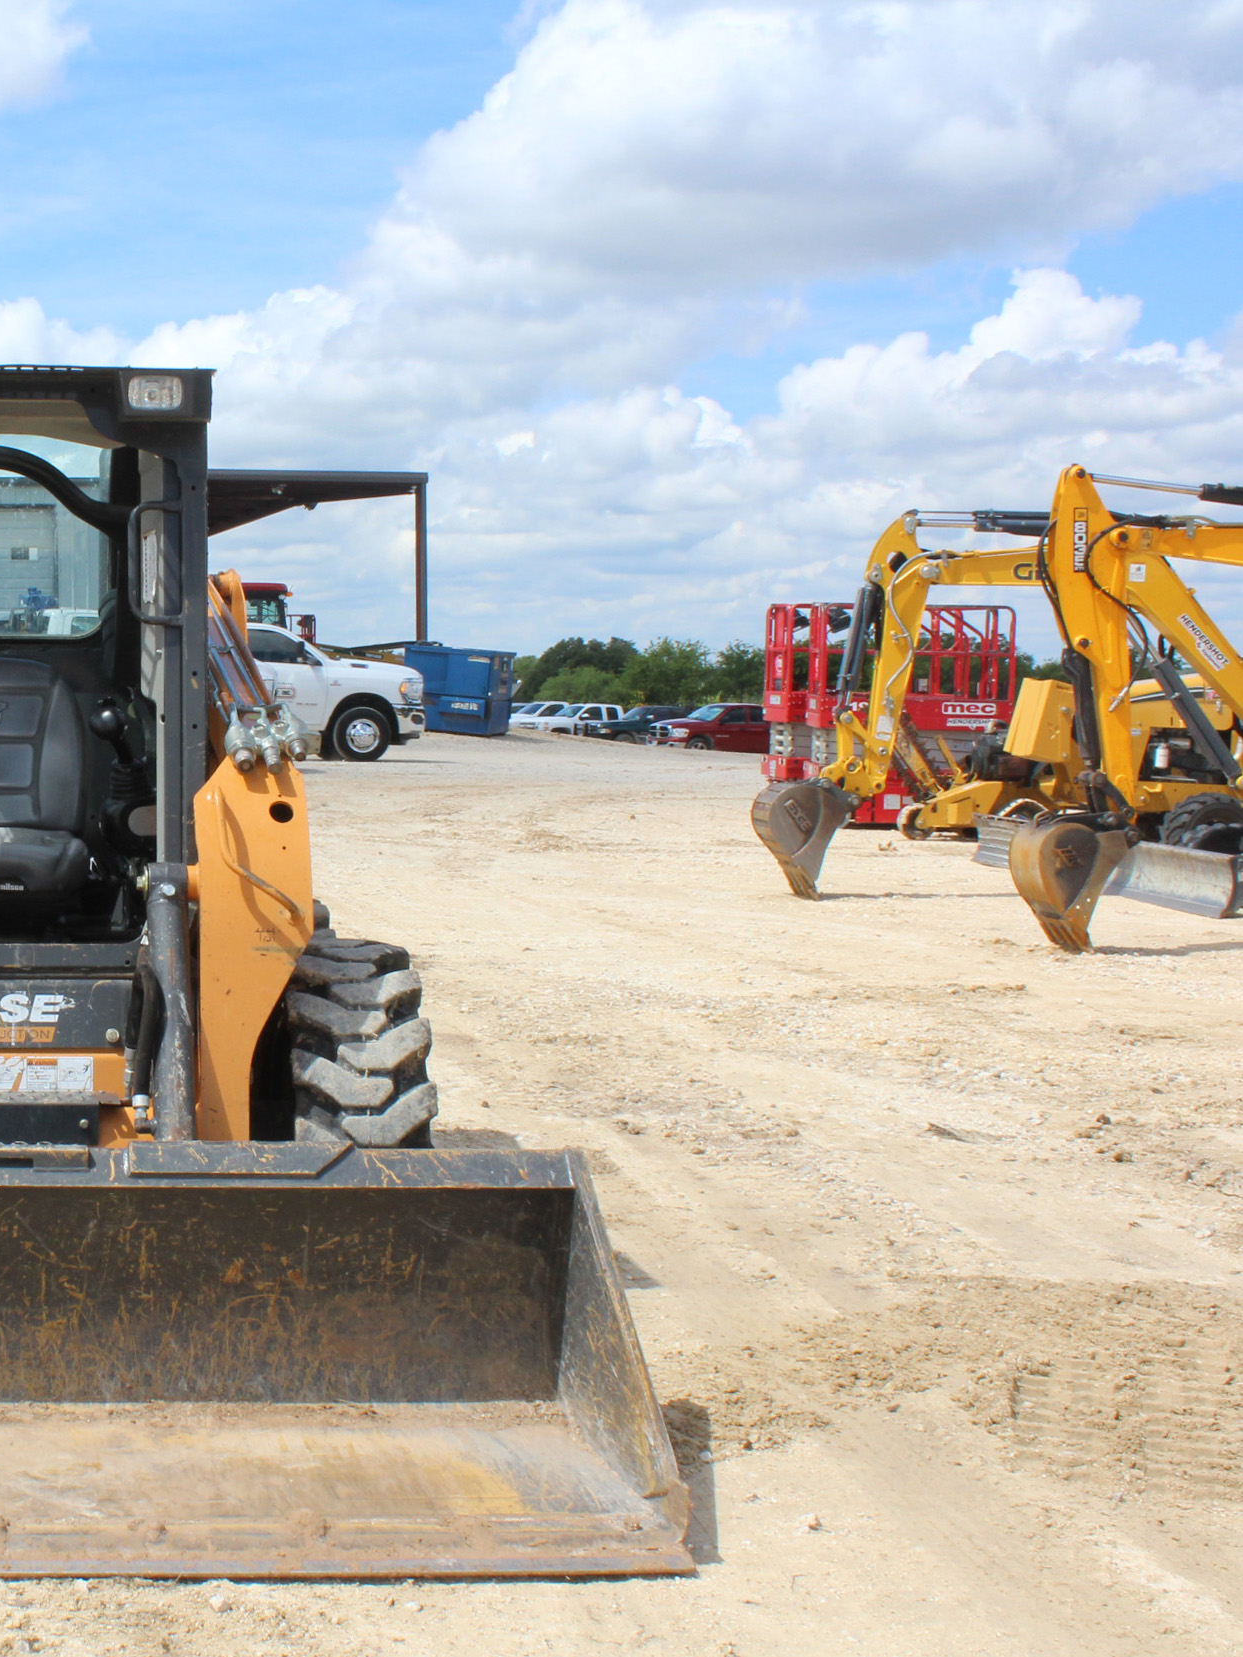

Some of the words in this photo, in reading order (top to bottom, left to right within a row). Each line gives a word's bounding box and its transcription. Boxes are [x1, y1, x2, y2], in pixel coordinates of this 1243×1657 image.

[1180, 614, 1230, 665] HENDERSHOT
[943, 703, 995, 714] mec
[947, 718, 991, 726] HENDERSH
